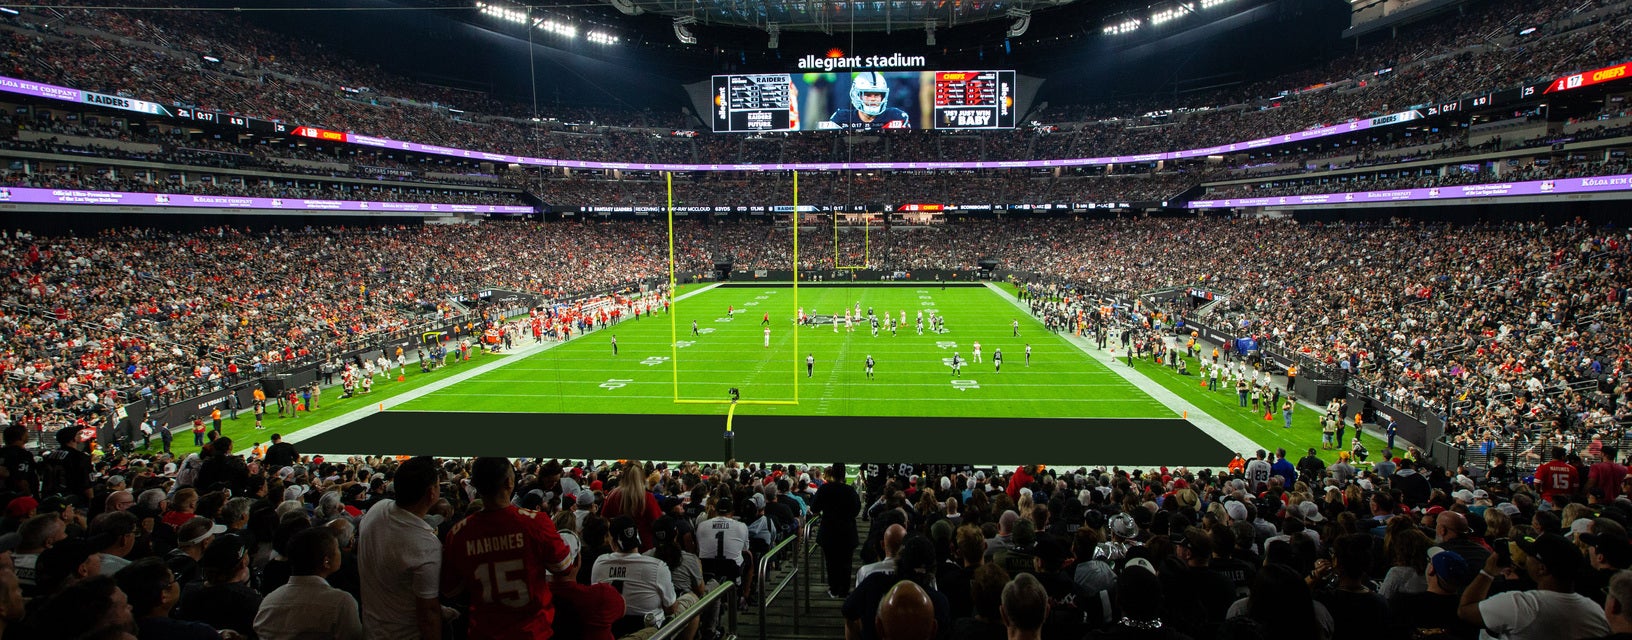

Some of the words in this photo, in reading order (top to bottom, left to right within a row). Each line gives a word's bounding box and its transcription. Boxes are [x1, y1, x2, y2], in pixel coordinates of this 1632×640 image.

[798, 55, 861, 71] allegiant
[865, 53, 925, 67] stadium
[1570, 76, 1579, 86] 17
[1593, 66, 1626, 82] CHIEFS
[0, 80, 18, 88] LOA
[20, 82, 38, 91] RUM
[40, 86, 78, 97] COMPANY
[1524, 86, 1534, 96] 25
[87, 94, 130, 108] RAIDERS
[138, 102, 144, 110] 7
[718, 86, 726, 120] allegiant
[1000, 82, 1009, 116] allegiant
[1443, 103, 1456, 112] 0:17
[198, 112, 213, 121] 0:17
[958, 116, 991, 126] BABY
[1372, 115, 1396, 125] RAIDERS
[208, 398, 222, 406] VEGAS
[899, 463, 913, 477] 83
[1255, 470, 1268, 481] 83
[1552, 474, 1569, 489] 15
[466, 532, 524, 556] MAHOMES
[715, 530, 726, 560] 1
[609, 566, 626, 578] CARR
[474, 560, 530, 608] 15
